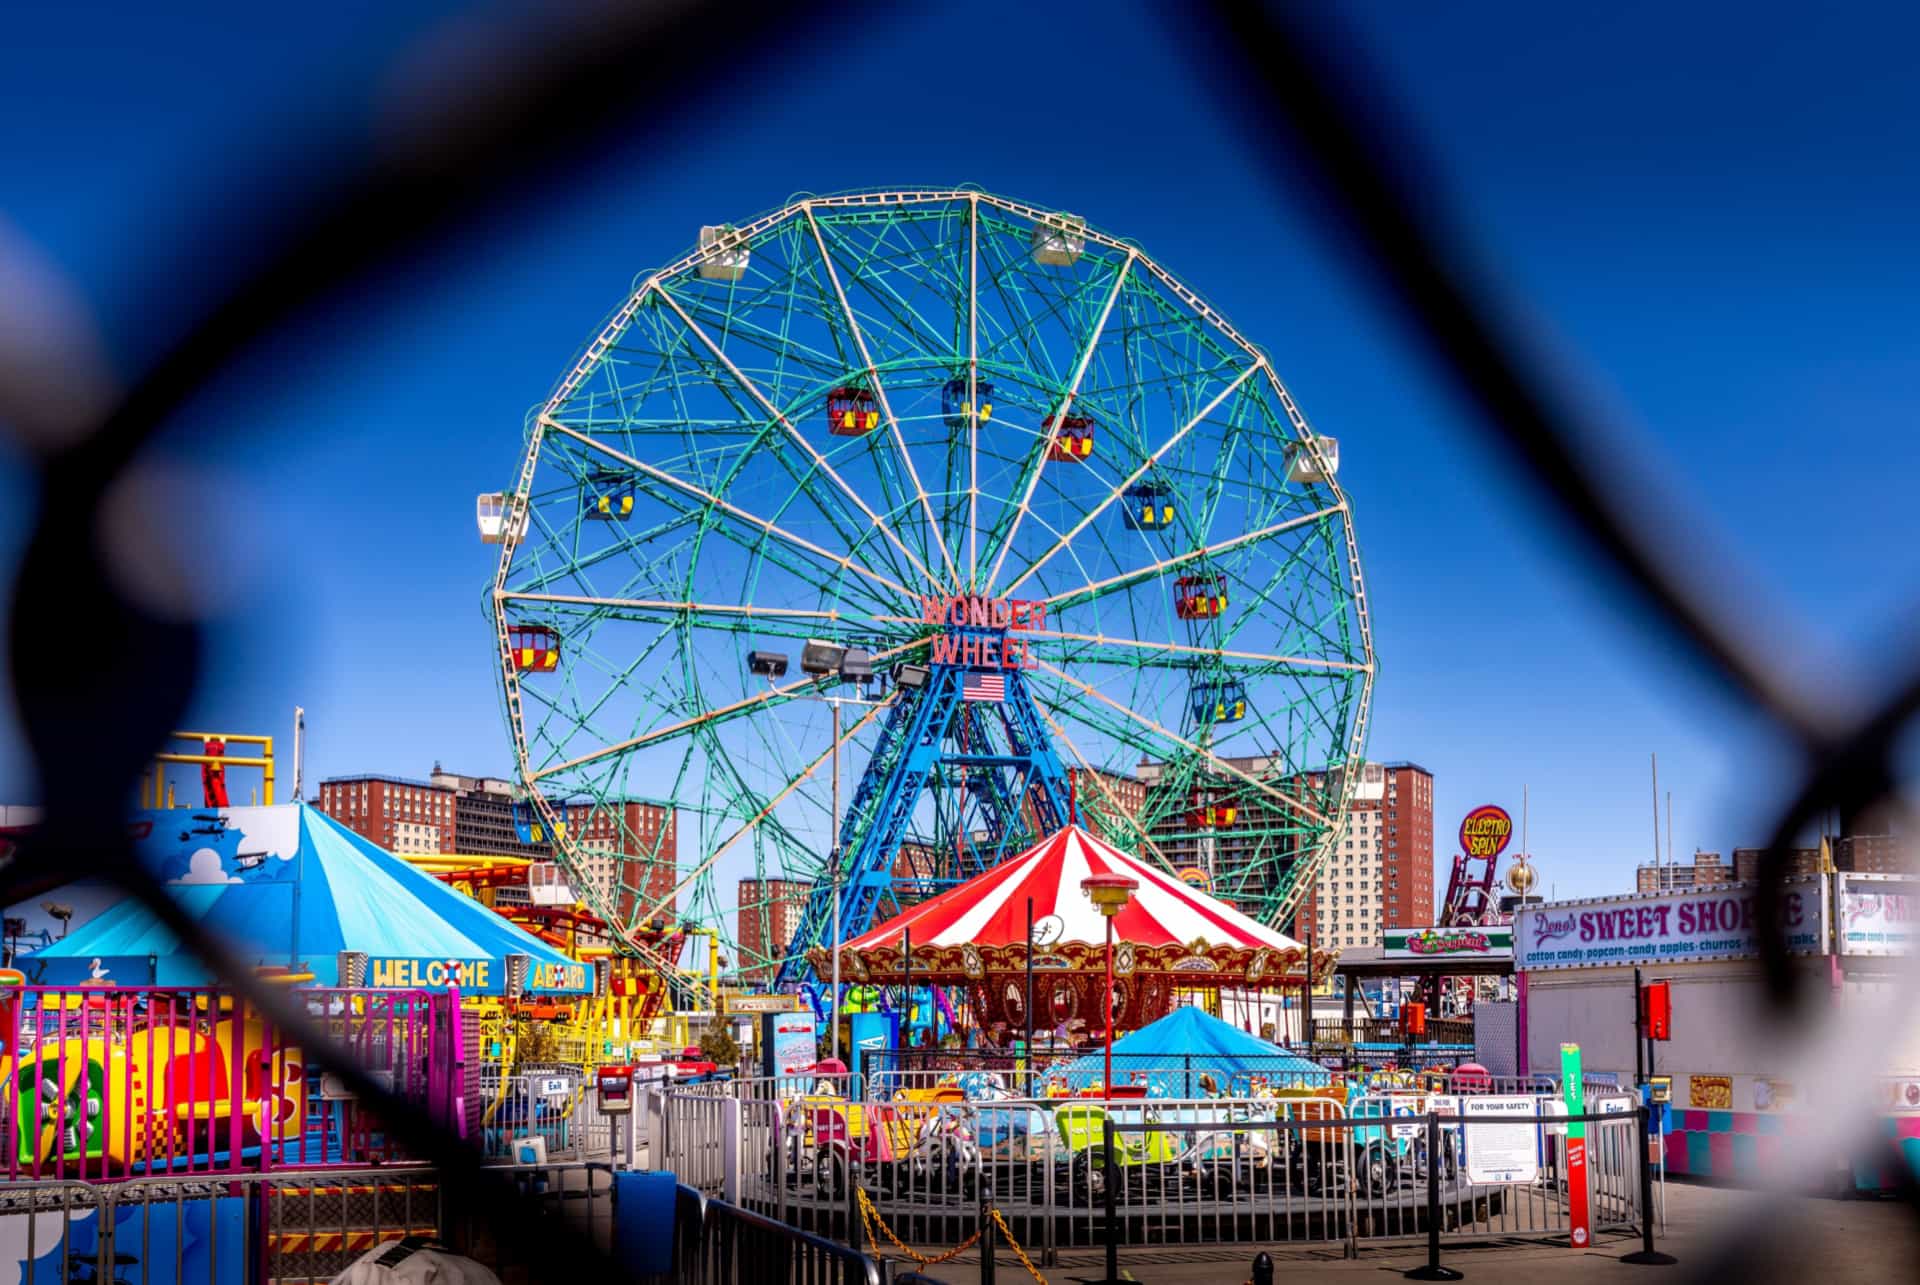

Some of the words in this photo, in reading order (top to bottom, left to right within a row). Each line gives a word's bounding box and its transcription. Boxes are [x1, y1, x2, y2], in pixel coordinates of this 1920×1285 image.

[921, 594, 1047, 631] WONDER
[931, 633, 1040, 670] WHEEL
[1464, 817, 1510, 835] ELECTRO
[1470, 837, 1498, 855] SPIN
[1579, 904, 1671, 942] SWEET
[1526, 951, 1555, 962] cotton
[1557, 948, 1583, 961] candy
[1586, 947, 1625, 960] popcorn
[1628, 943, 1657, 957] candy
[1660, 940, 1694, 955] apples
[1700, 937, 1741, 951] churros
[373, 959, 489, 988] WELCOME
[532, 963, 586, 990] ABOARD
[548, 1081, 562, 1091] Exit
[1471, 1103, 1485, 1111] FOR
[1487, 1103, 1505, 1111] YOUR
[1506, 1102, 1529, 1111] SAFETY
[1606, 1103, 1624, 1113] Enter
